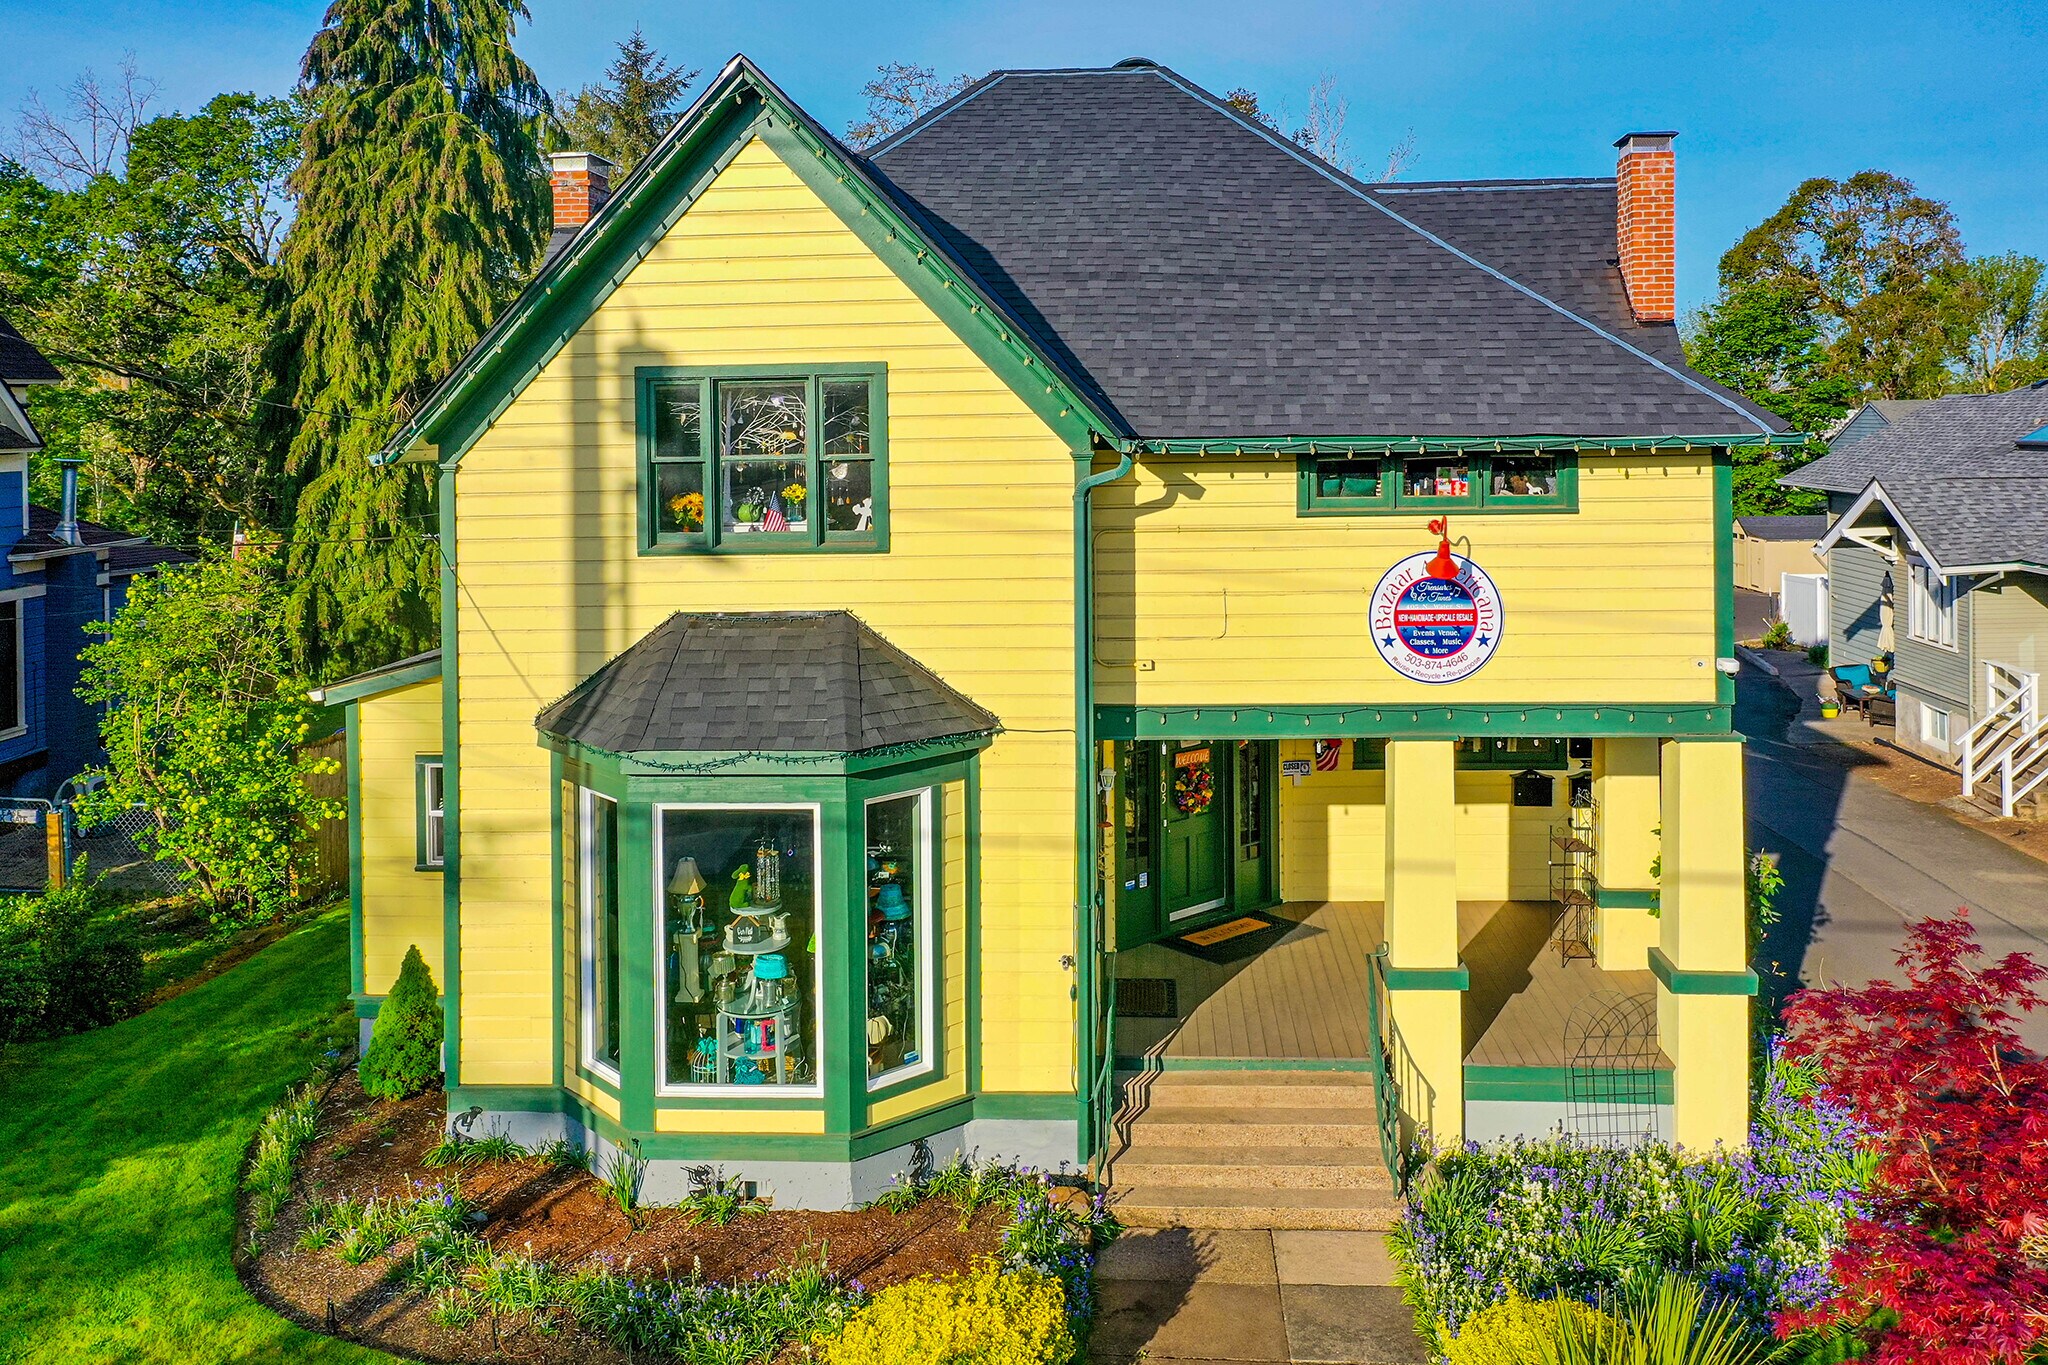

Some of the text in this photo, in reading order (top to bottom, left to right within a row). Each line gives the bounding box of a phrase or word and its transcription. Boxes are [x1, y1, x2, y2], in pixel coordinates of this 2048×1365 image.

[1416, 581, 1453, 592] Treasures
[1375, 568, 1414, 630] Bazaar
[1418, 592, 1452, 602] & Tunes
[1456, 613, 1474, 622] RESALE
[1442, 638, 1464, 646] Music,
[1392, 656, 1482, 680] Reuse Recycle Re-purpose
[1404, 652, 1469, 670] 503-874-4646
[1175, 750, 1210, 767] WELCOME
[1198, 921, 1250, 941] WELCOME
